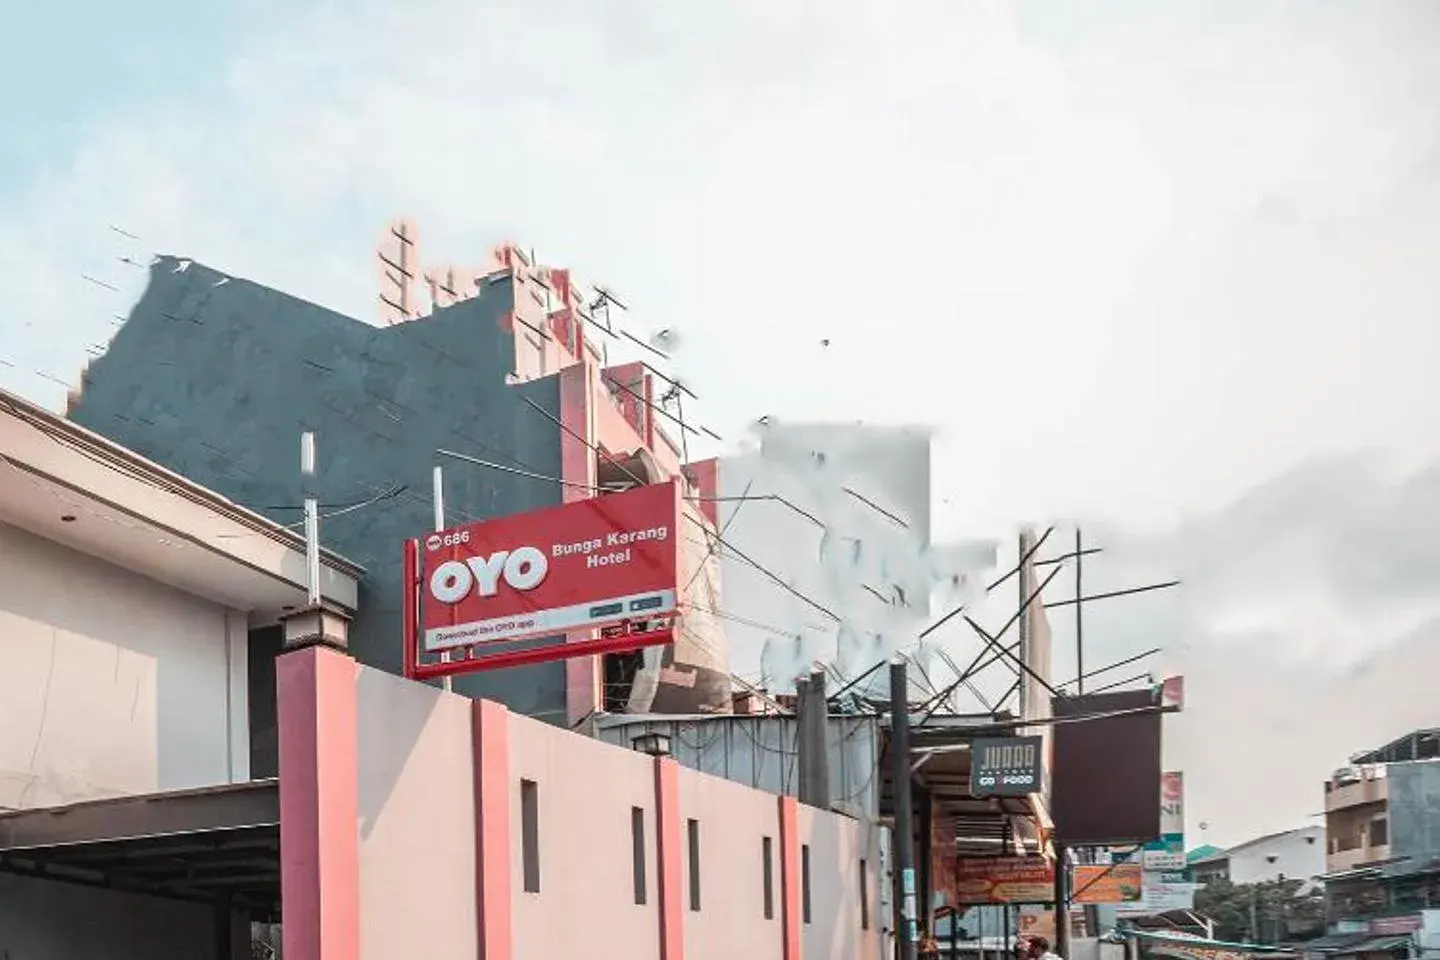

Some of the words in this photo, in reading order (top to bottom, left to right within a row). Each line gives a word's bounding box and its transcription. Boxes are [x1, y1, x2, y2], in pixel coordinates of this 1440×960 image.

[444, 531, 470, 546] 686
[552, 538, 602, 557] Bunga
[606, 526, 667, 546] Karang
[587, 548, 631, 568] Hotel
[430, 546, 548, 603] OYO
